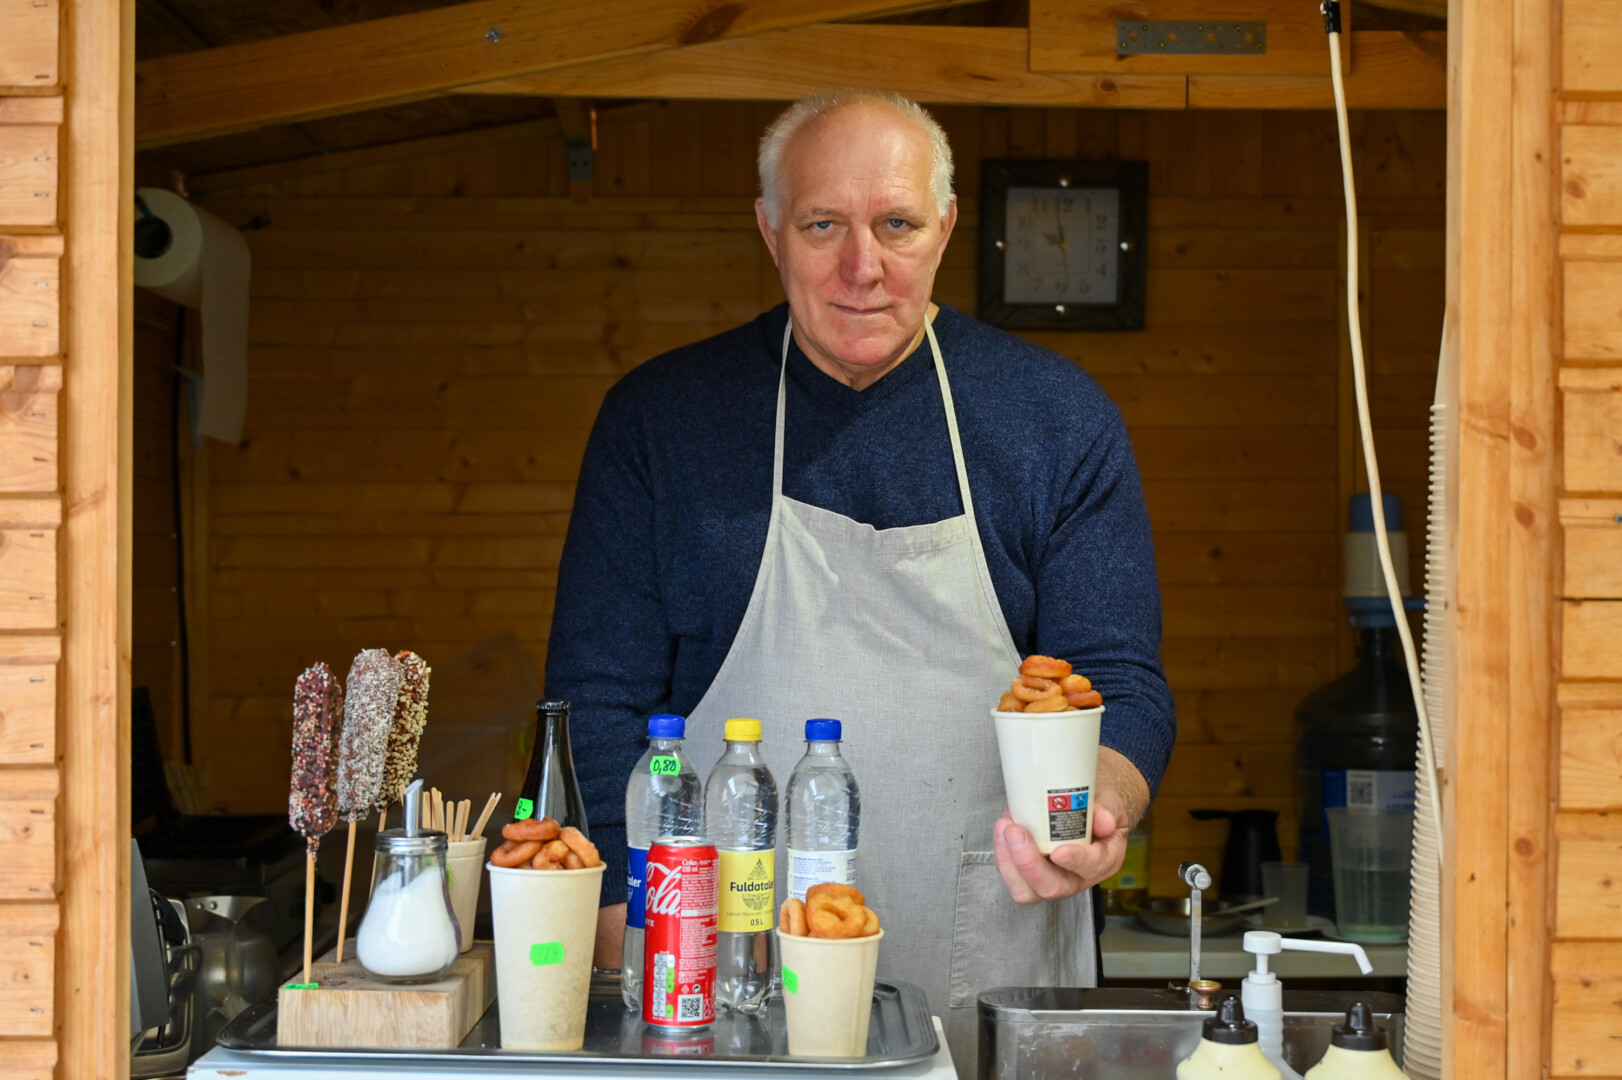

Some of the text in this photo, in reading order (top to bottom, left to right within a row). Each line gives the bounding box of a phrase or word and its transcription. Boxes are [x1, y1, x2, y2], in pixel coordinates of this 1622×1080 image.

[1032, 198, 1048, 213] 11
[1095, 214, 1107, 231] 2
[653, 759, 677, 774] 0,80
[645, 862, 682, 915] ola
